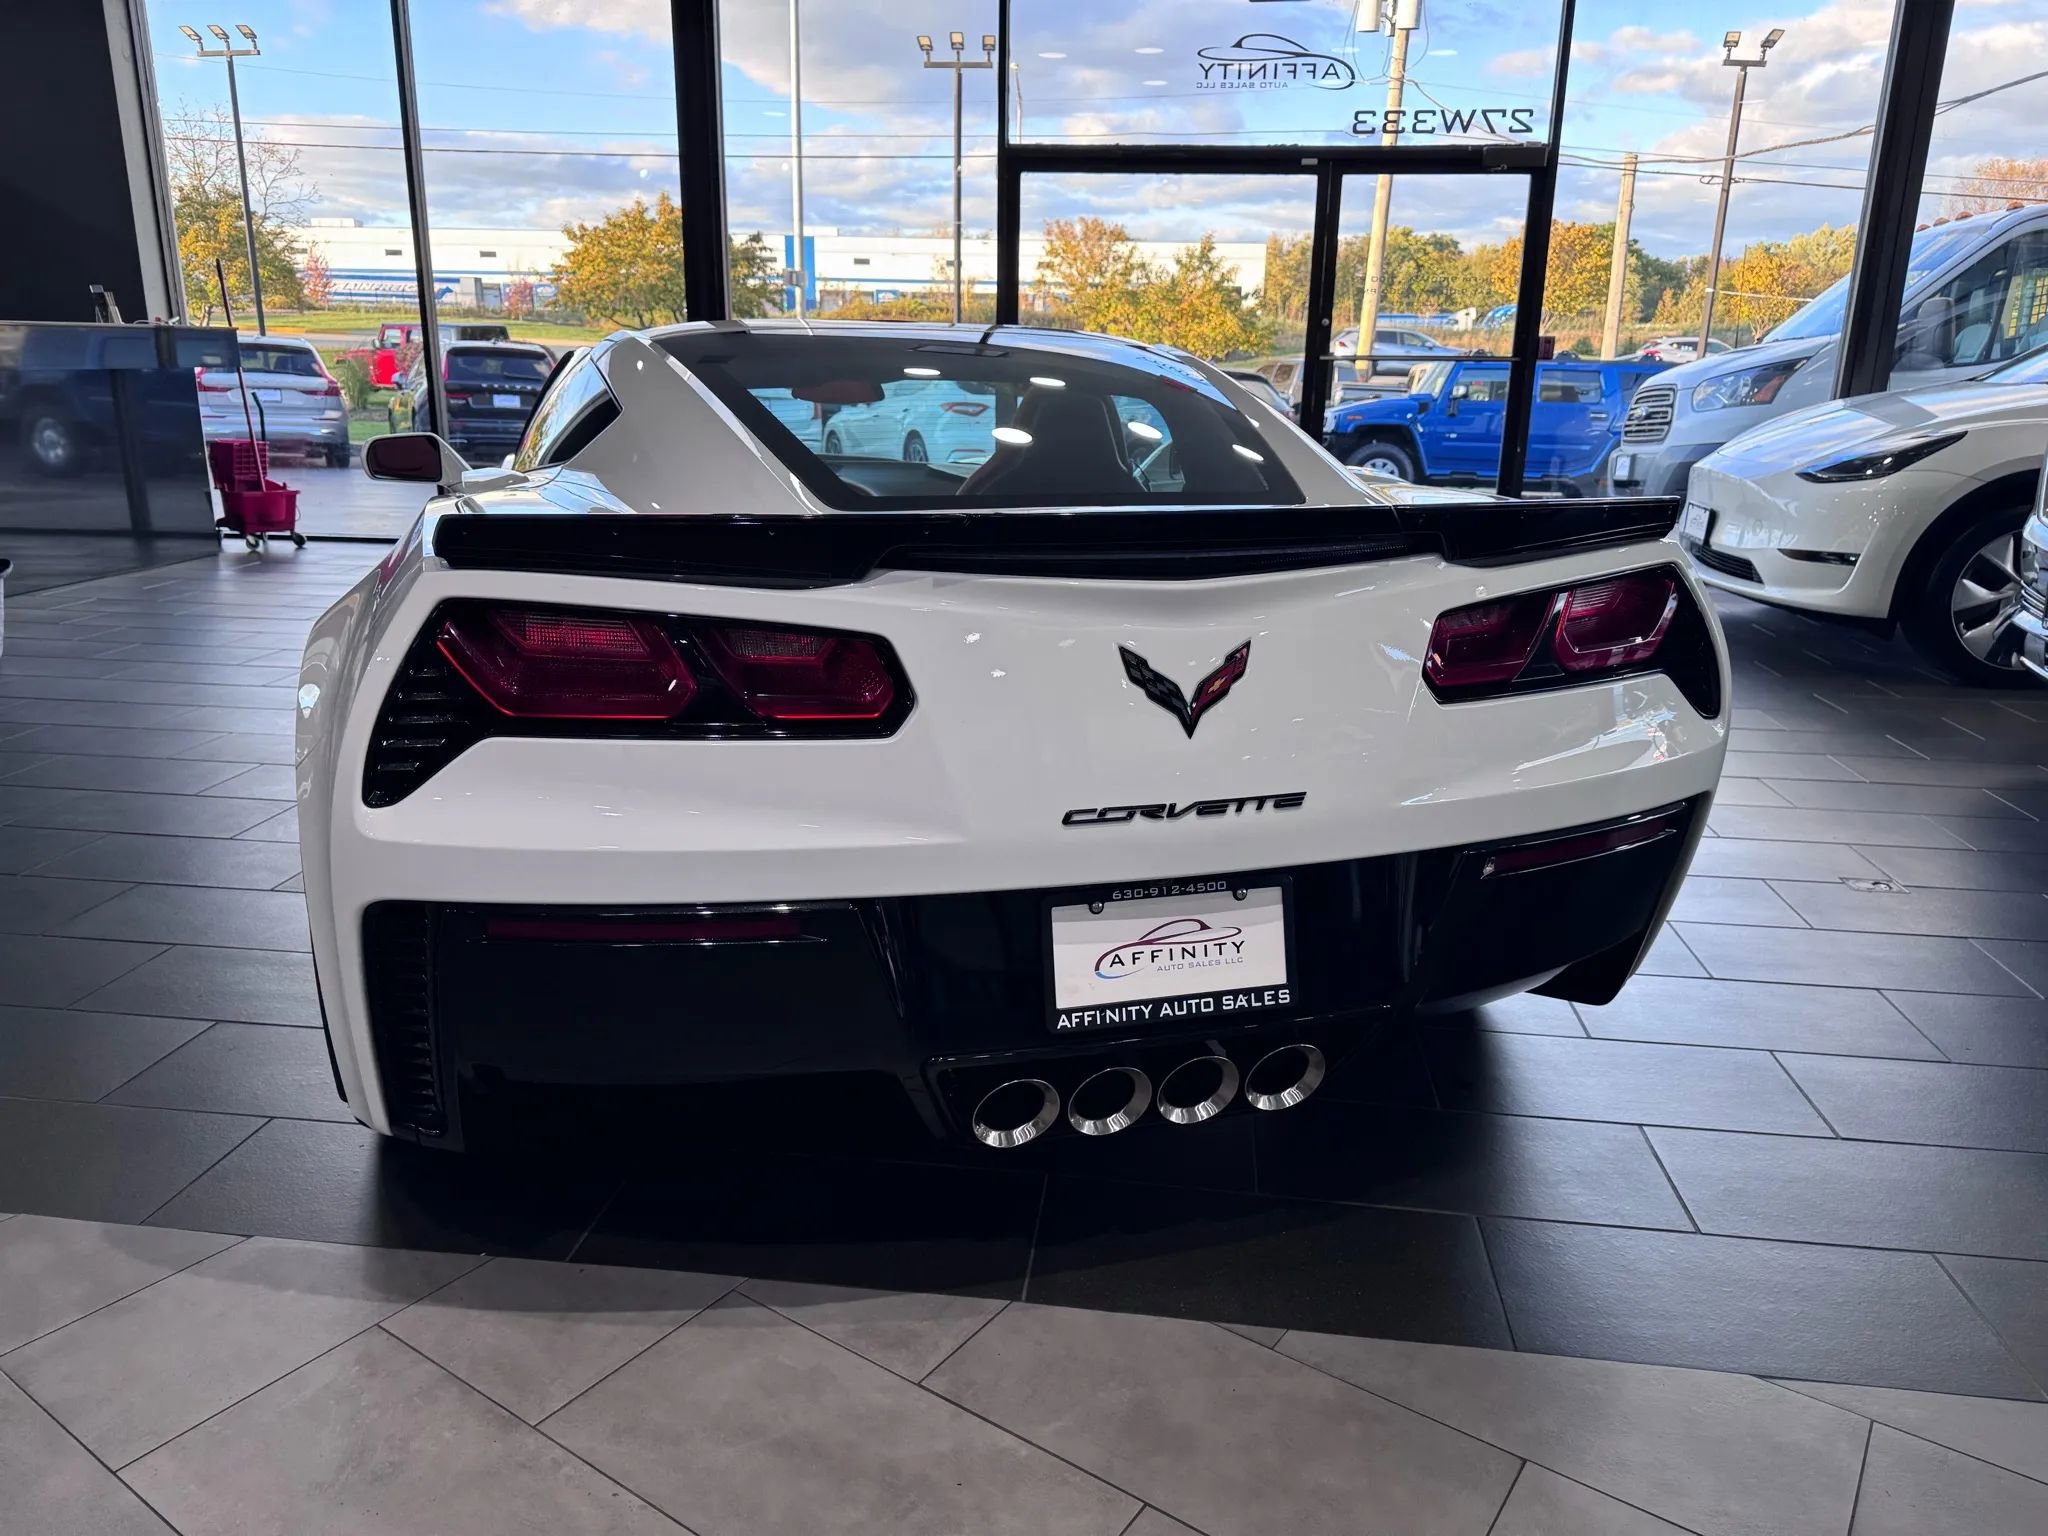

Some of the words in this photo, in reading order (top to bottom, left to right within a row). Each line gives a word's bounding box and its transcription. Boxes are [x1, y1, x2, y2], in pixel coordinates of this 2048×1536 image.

[1061, 791, 1308, 826] CORVETTE
[1112, 880, 1227, 900] 630-912-4500
[1109, 940, 1246, 968] AFFINITY
[1156, 962, 1184, 972] AUTO
[1188, 959, 1221, 969] SALES
[1225, 956, 1244, 965] LLC
[1057, 1004, 1153, 1030] AFFINITY
[1159, 998, 1214, 1018] AUTO
[1222, 989, 1291, 1011] SALES
